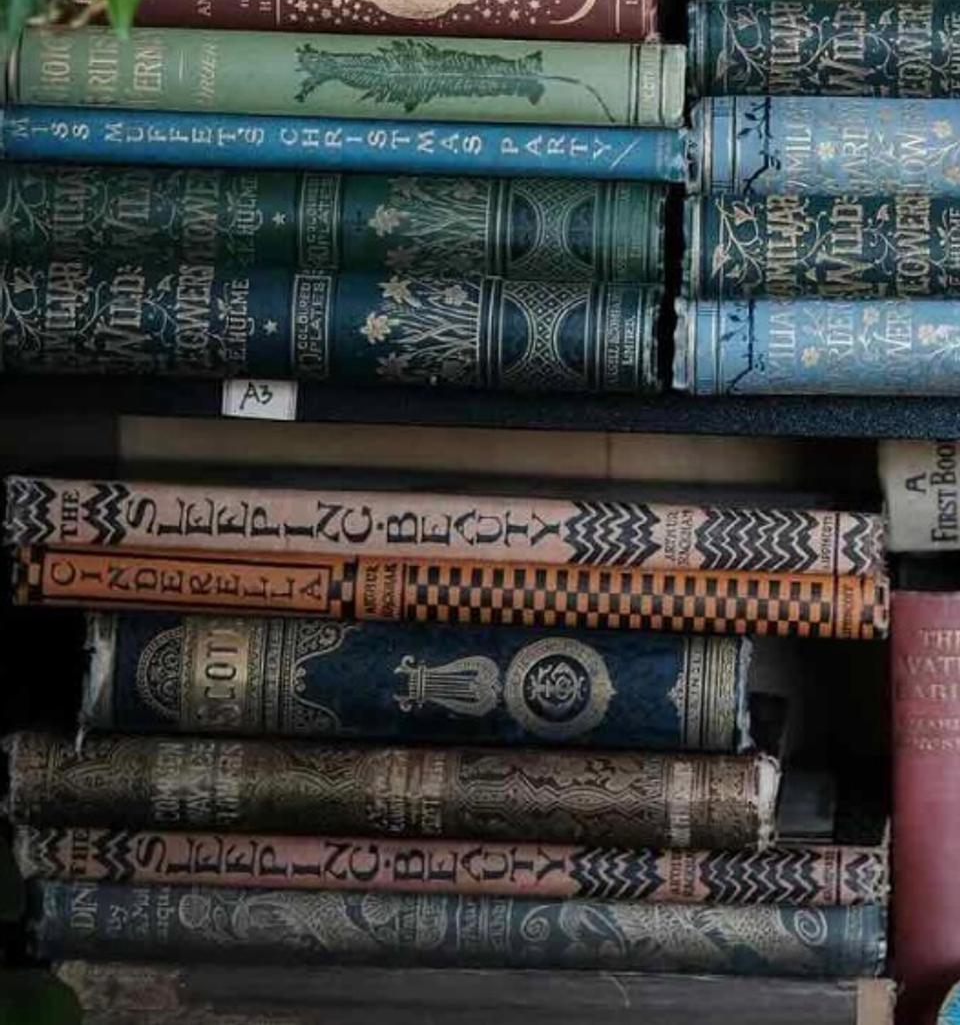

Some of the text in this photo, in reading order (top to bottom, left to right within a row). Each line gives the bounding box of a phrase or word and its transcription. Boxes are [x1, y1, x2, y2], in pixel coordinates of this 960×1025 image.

[40, 35, 72, 98] HOIC
[768, 1, 804, 95] AMILIAR
[825, 9, 868, 93] WILD
[12, 117, 613, 159] MISS MUFFET'S CHRISTMAS PARTY
[765, 194, 802, 296] AMILIAR
[817, 204, 873, 297] WILD
[229, 277, 252, 343] HULME
[298, 282, 310, 352] COLOURED
[311, 282, 325, 354] PLATES
[240, 381, 273, 410] A3
[906, 473, 926, 494] A
[931, 441, 959, 544] FIRST BOO
[60, 488, 80, 540] THE
[125, 495, 561, 549] SLEEPING BEAUTY
[664, 510, 678, 562] ARTHUR
[678, 509, 692, 567] RACKHAM
[50, 559, 324, 602] CINDERELLA
[70, 828, 90, 874] THE
[135, 835, 567, 883] SLEEPING BEAUTY
